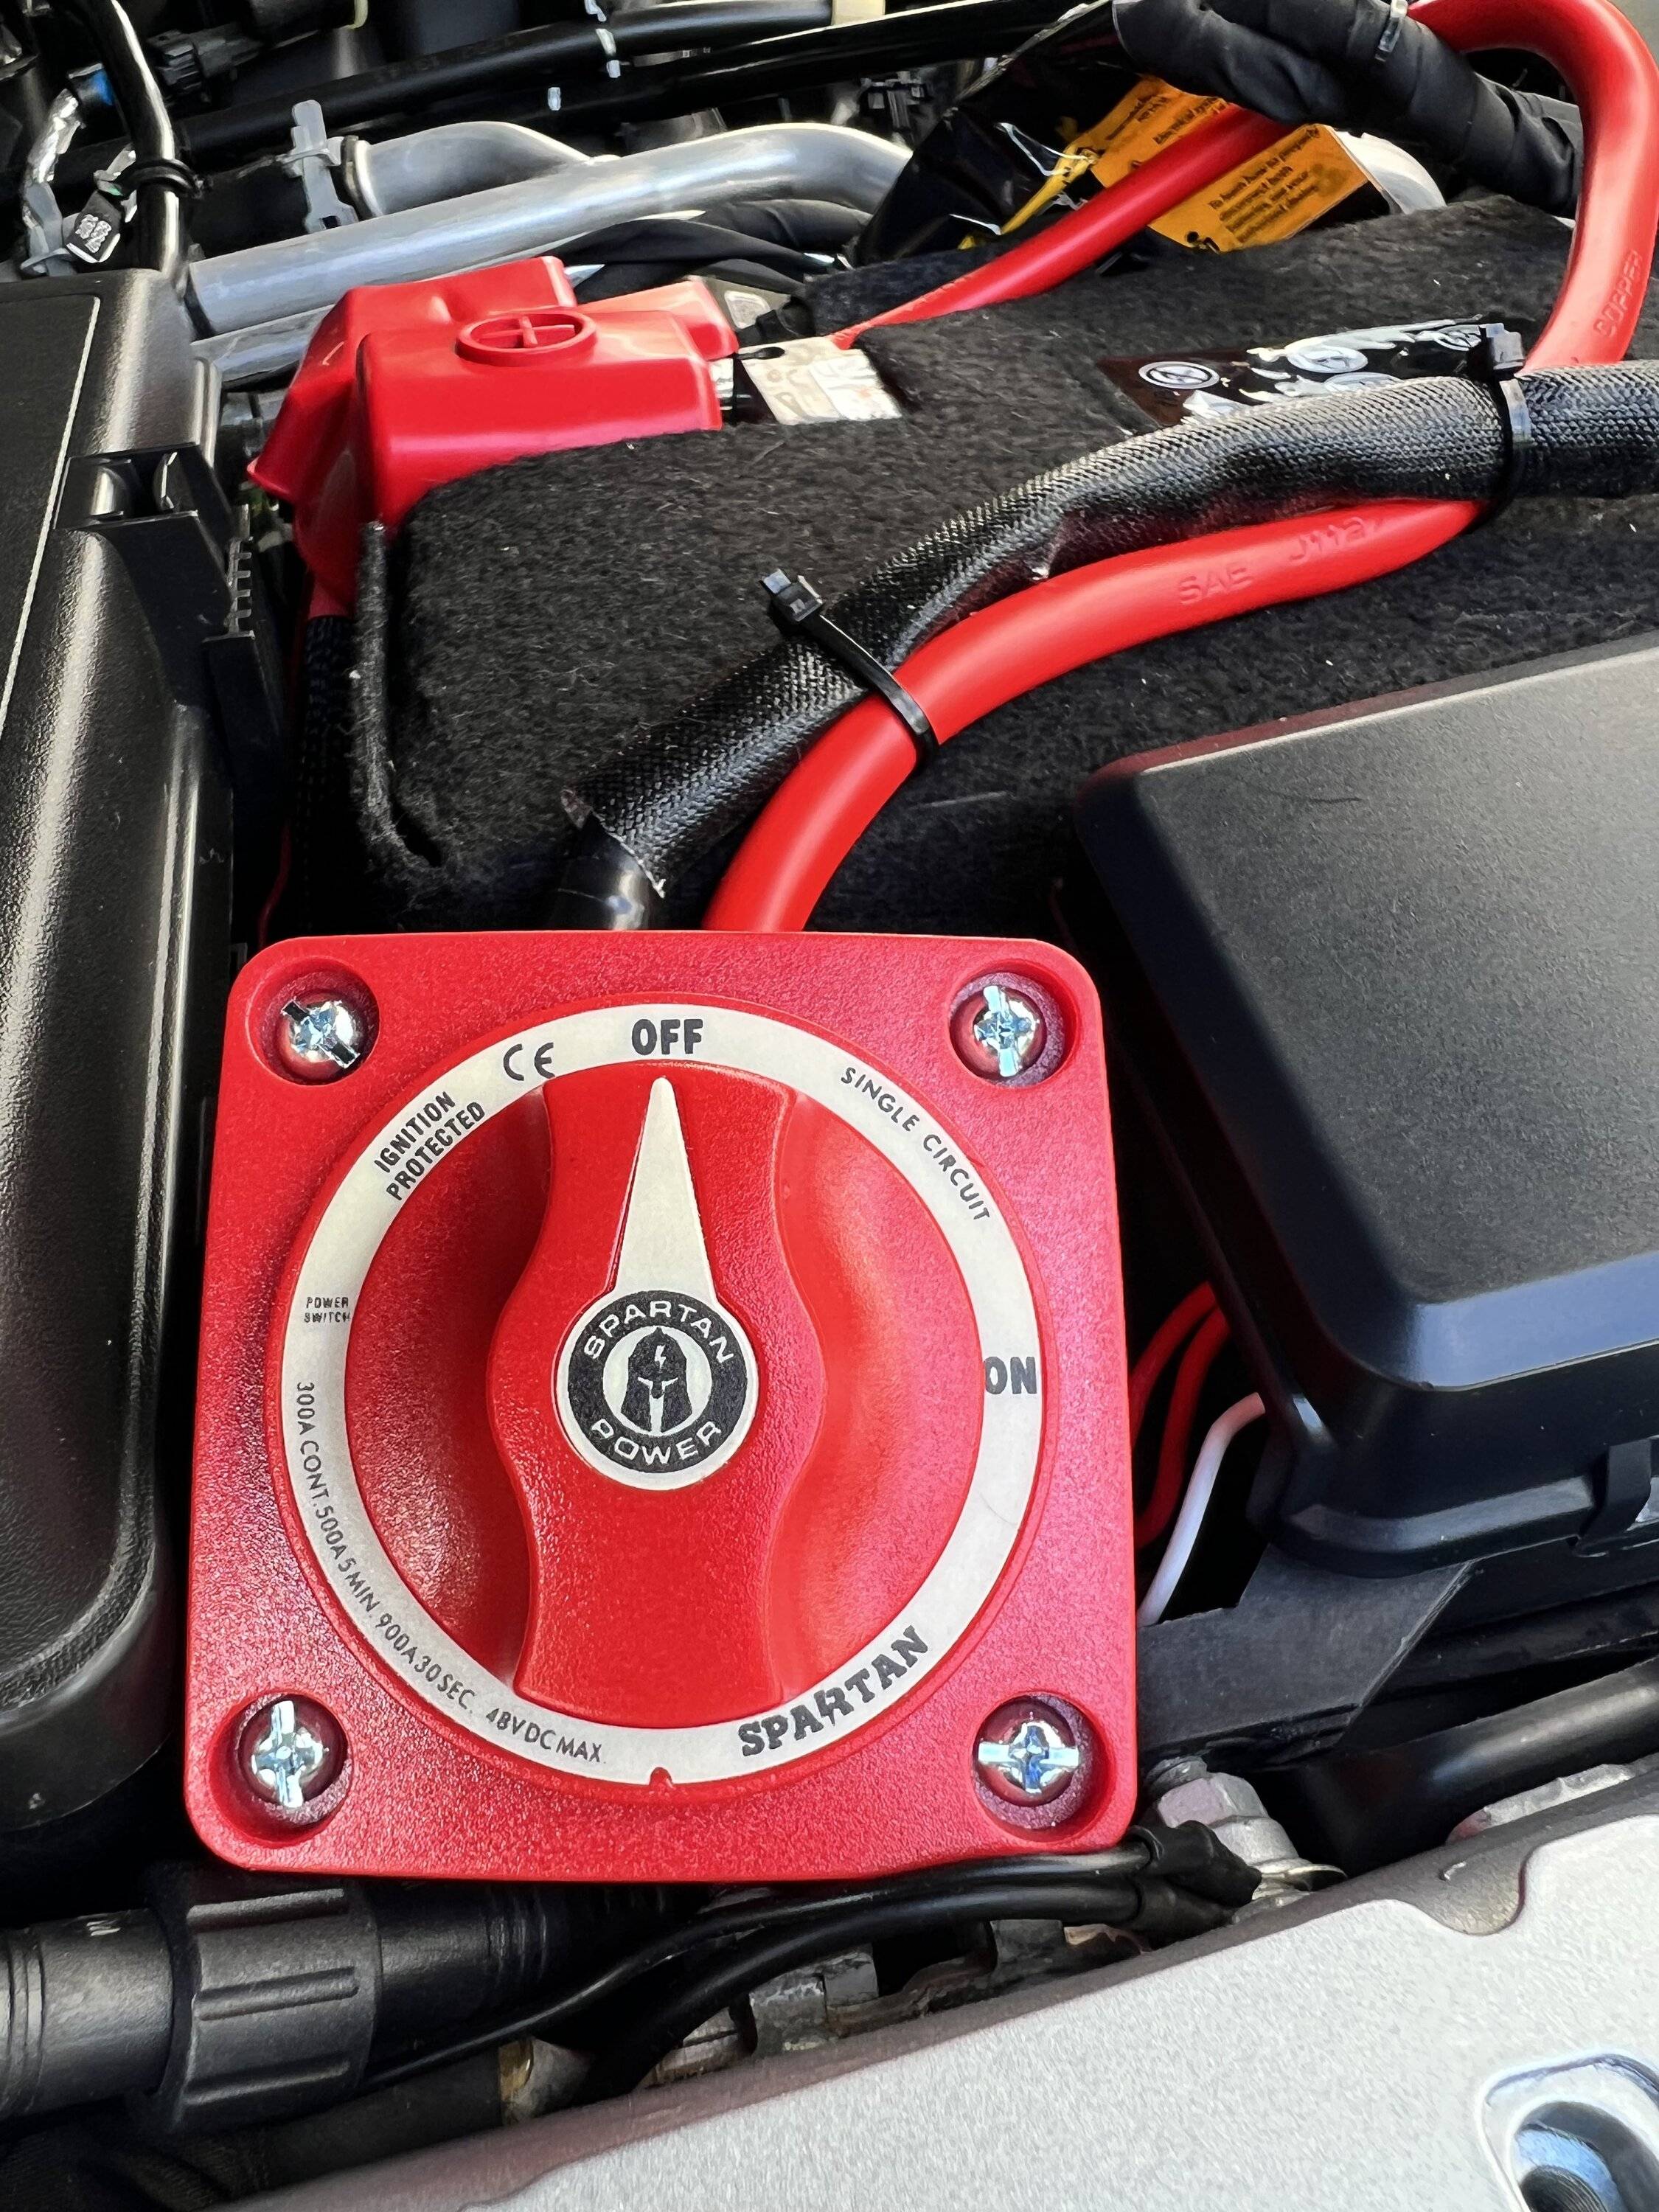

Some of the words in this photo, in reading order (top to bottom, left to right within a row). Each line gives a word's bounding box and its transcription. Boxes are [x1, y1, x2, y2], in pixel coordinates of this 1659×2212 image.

[1175, 560, 1251, 605] SAE
[631, 1018, 703, 1056] OFF
[503, 1041, 556, 1082] CE
[374, 1091, 456, 1173] IGNITION
[386, 1102, 486, 1201] PROTECTED
[841, 1067, 920, 1132] SINGLE
[922, 1134, 990, 1220] CIRCUIT
[304, 1311, 352, 1324] SWITCH
[306, 1296, 349, 1309] POWER
[583, 1300, 734, 1363] SPARTAN
[983, 1356, 1037, 1395] ON
[296, 1382, 316, 1436] 300A
[590, 1417, 722, 1465] POWER
[738, 1624, 928, 1757] SPARTAN
